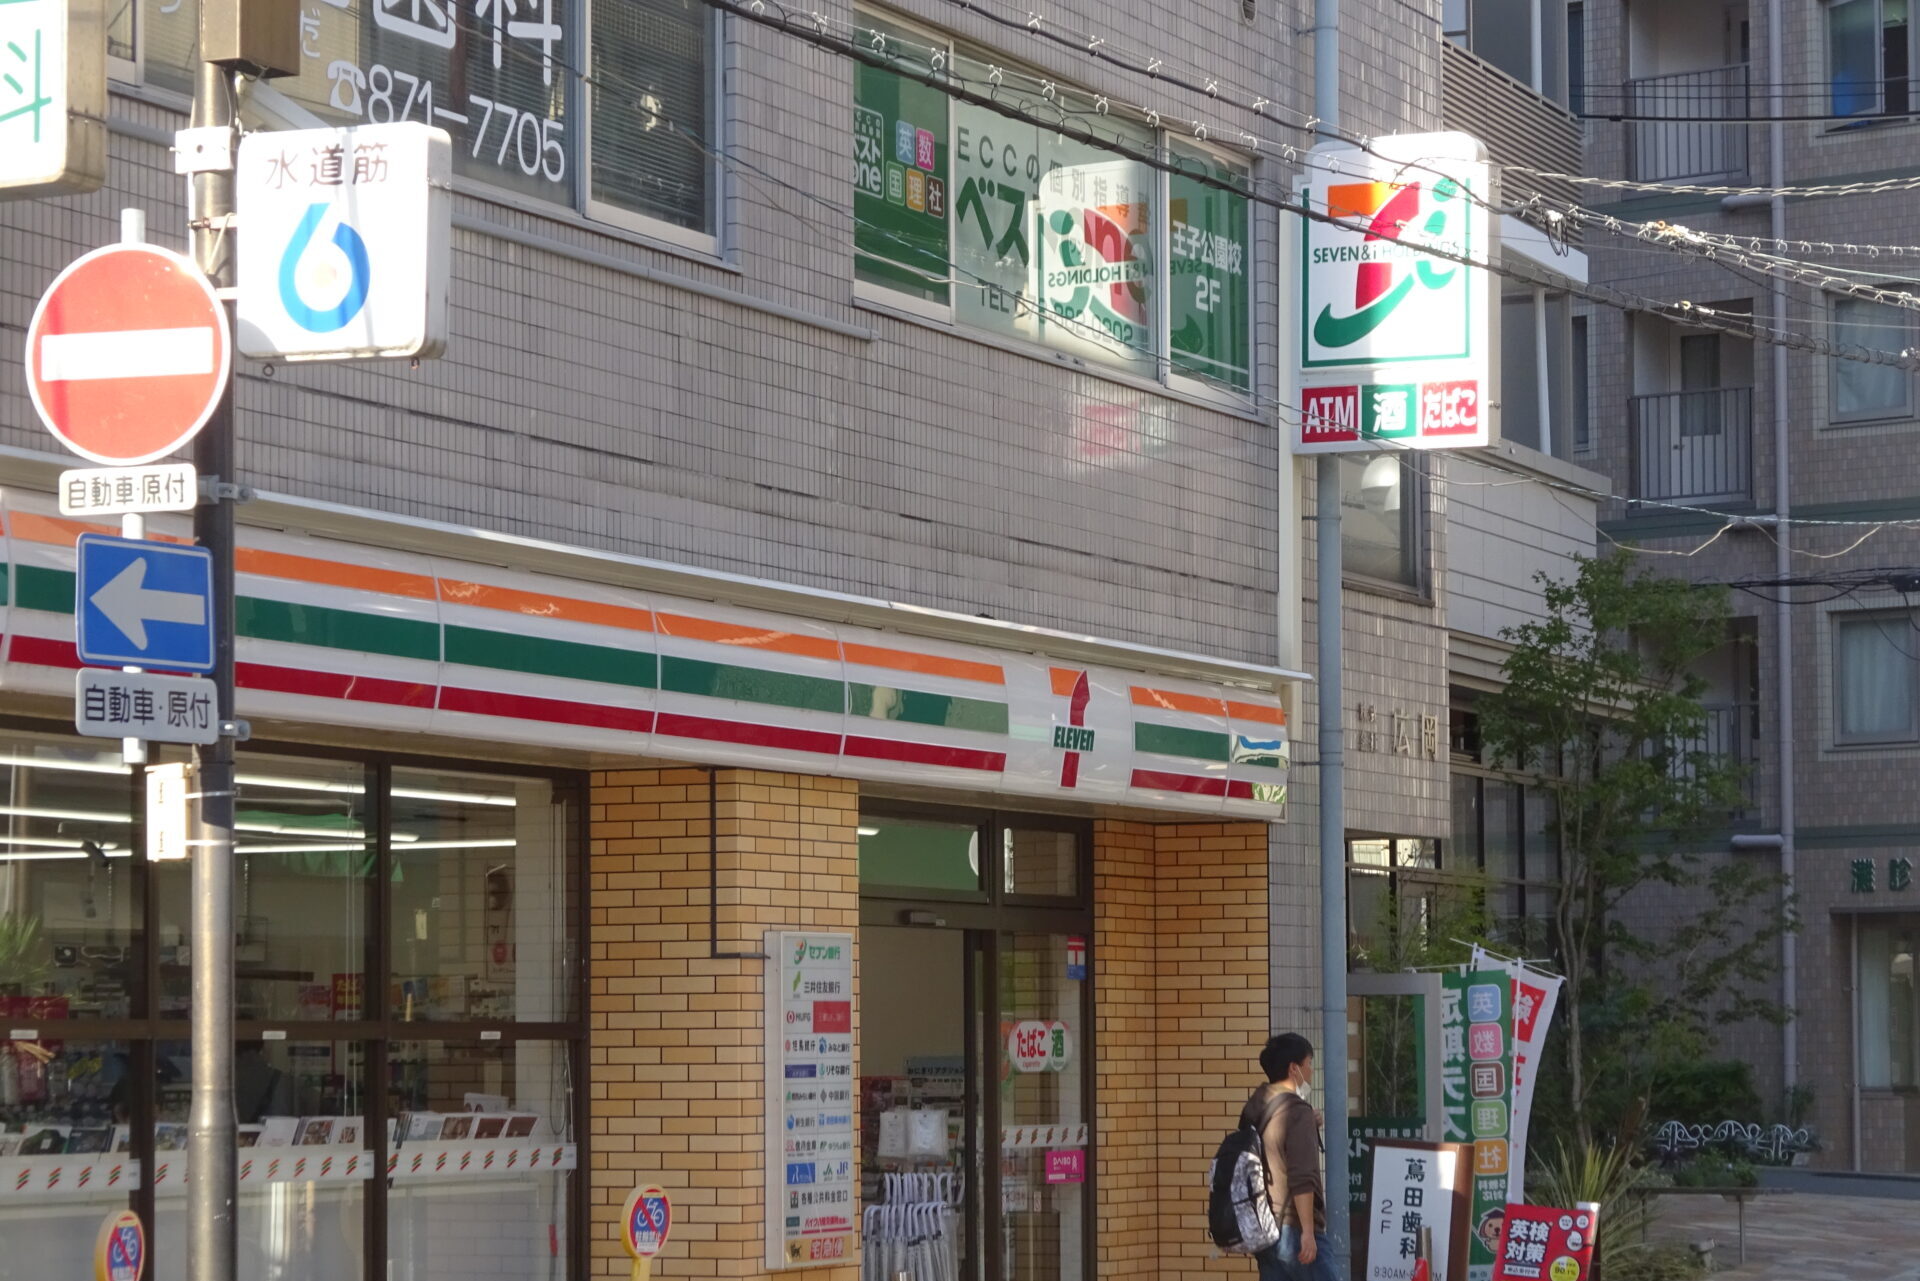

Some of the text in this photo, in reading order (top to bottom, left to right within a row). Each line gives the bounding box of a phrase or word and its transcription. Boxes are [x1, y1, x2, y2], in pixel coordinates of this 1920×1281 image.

[368, 64, 565, 183] 871-7705
[265, 143, 389, 189] 水道筋
[1172, 219, 1242, 277] 王子公園校
[1312, 242, 1377, 264] SEVEN&i
[1195, 275, 1221, 314] 2F
[1305, 395, 1355, 434] ATM
[1372, 390, 1408, 433] 酒
[1423, 388, 1477, 428] たばこ
[808, 945, 841, 960] セブン銀行
[803, 980, 841, 995] 三井住友銀行
[1016, 1029, 1046, 1058] たばこ
[1051, 1029, 1064, 1058] 酒
[826, 1064, 850, 1076] りそな銀行
[801, 1190, 848, 1205] 各種公共料金窓口
[1504, 1241, 1546, 1263] 対策
